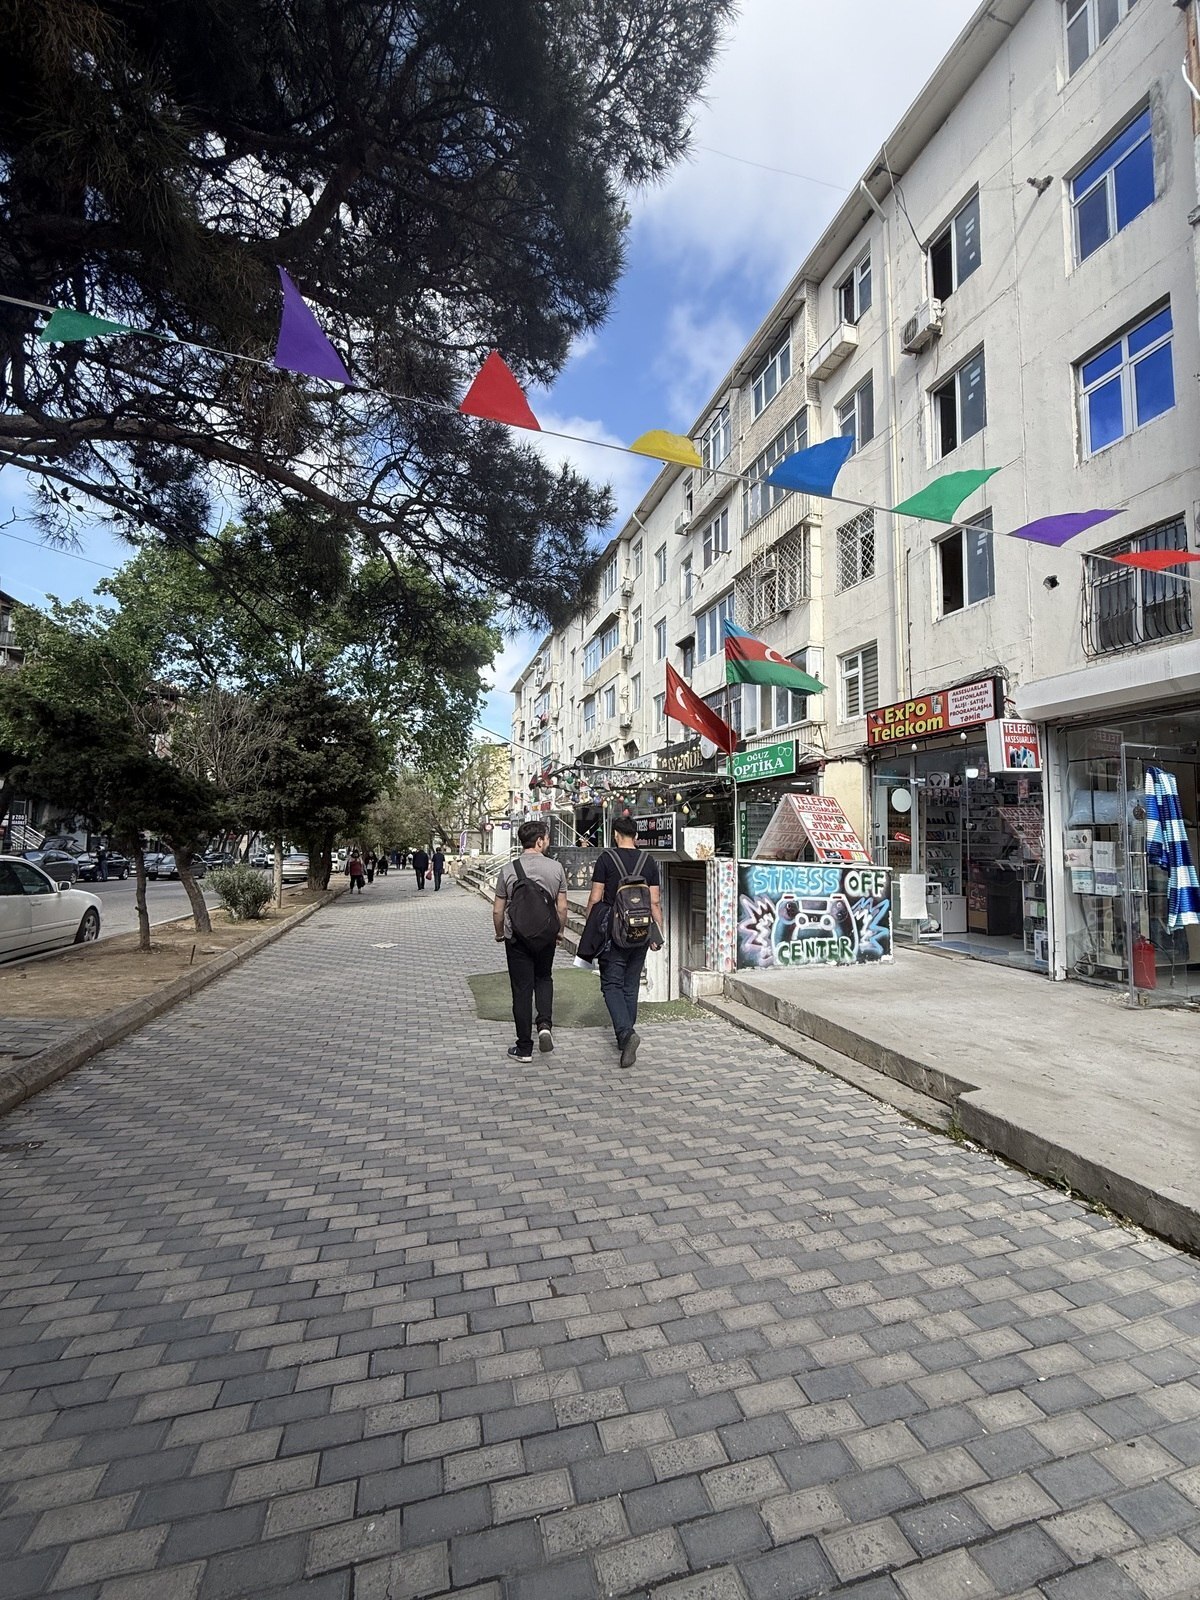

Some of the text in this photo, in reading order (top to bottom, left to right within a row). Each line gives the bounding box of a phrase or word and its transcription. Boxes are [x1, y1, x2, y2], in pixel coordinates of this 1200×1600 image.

[952, 683, 987, 696] AKSESUARLAR
[952, 690, 989, 703] TELEFONLARIN
[884, 702, 927, 724] ExPo
[960, 712, 981, 722] TƏMİR
[872, 716, 944, 743] Telekom
[1003, 723, 1036, 735] TELEFON
[746, 751, 770, 762] OĞUZ
[733, 757, 785, 777] OPTİKA
[793, 796, 838, 808] TELEFON
[811, 831, 858, 844] SAATLAR
[753, 868, 886, 896] STRESS OFF
[777, 936, 855, 965] CENTER
